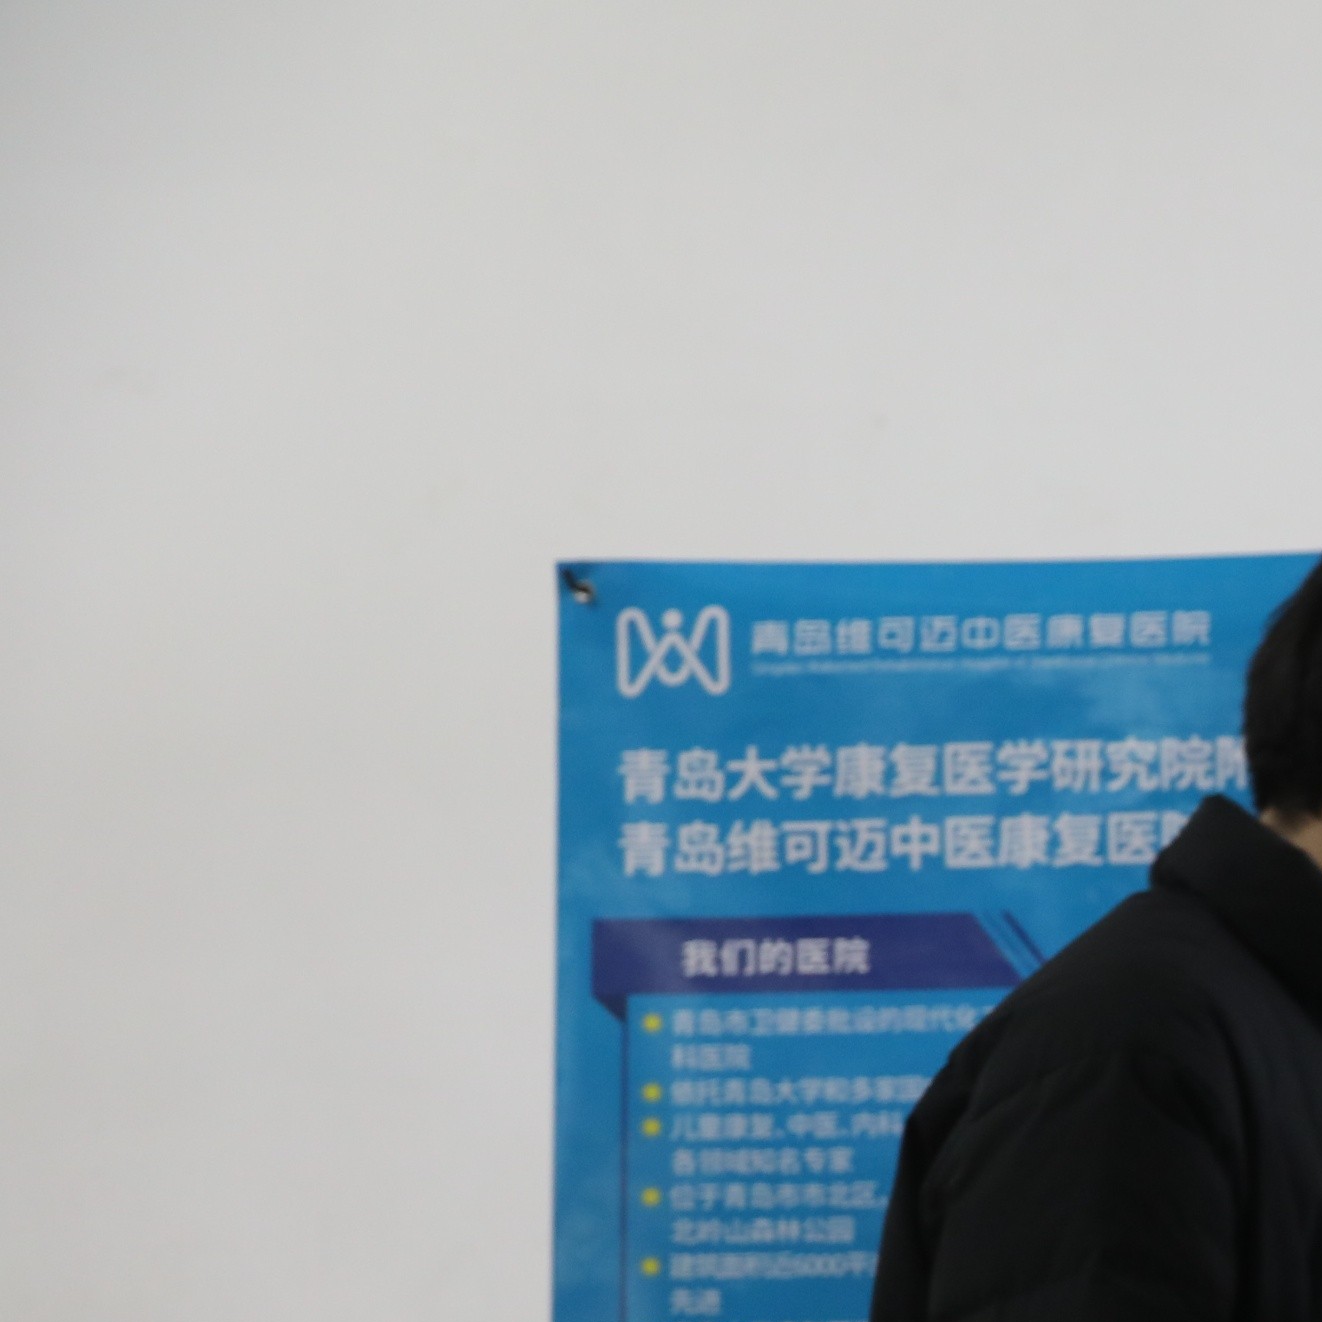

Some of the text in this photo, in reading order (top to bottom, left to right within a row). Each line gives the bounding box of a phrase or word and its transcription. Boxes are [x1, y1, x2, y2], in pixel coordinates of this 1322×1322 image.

[752, 612, 1210, 655] 青岛维可迈中医康复医院
[681, 936, 871, 976] 我们的医院
